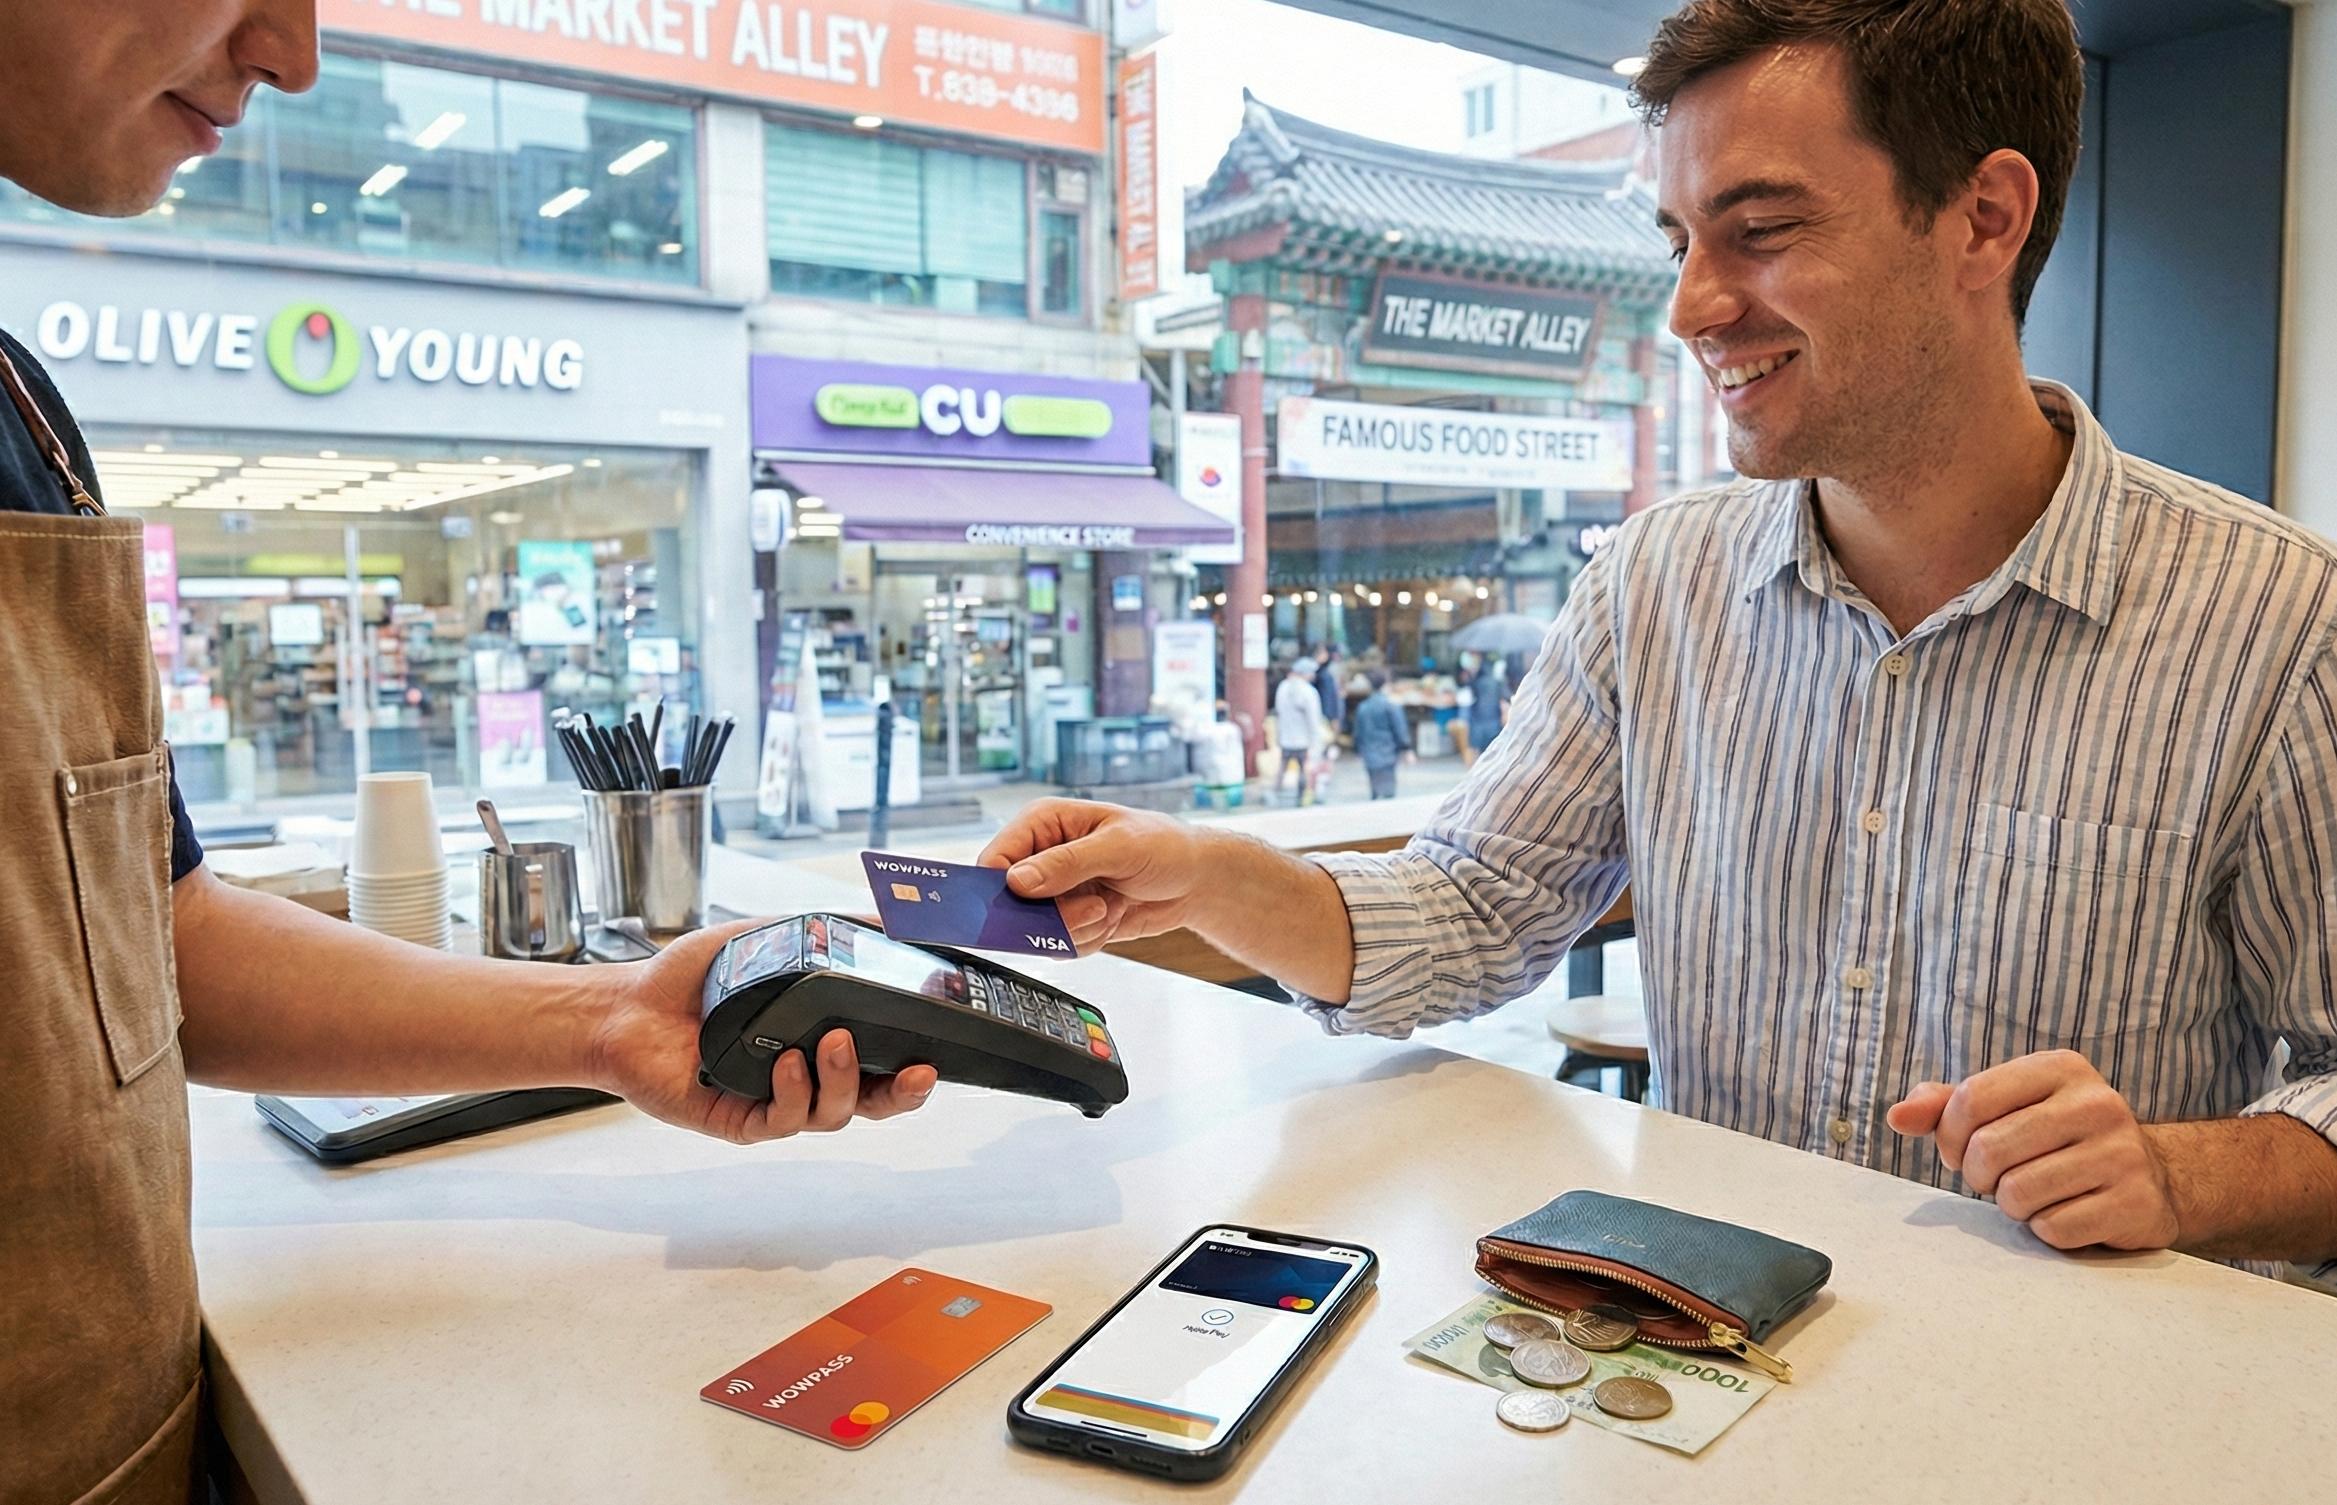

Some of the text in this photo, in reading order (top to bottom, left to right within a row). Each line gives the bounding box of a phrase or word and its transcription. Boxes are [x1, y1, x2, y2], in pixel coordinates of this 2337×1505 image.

[730, 0, 889, 89] ALLEY
[37, 301, 586, 390] OLIVE YOUNG
[1382, 295, 1593, 353] THE MARKET ALLEY
[920, 384, 1001, 437] CU
[1322, 415, 1601, 462] FAMOUS FOOD STREET
[1083, 525, 1136, 547] STORE
[873, 860, 948, 878] WOWPASS
[1025, 934, 1071, 952] VISA
[762, 1354, 854, 1409] WOWPASS
[1680, 1363, 1750, 1393] 1000
